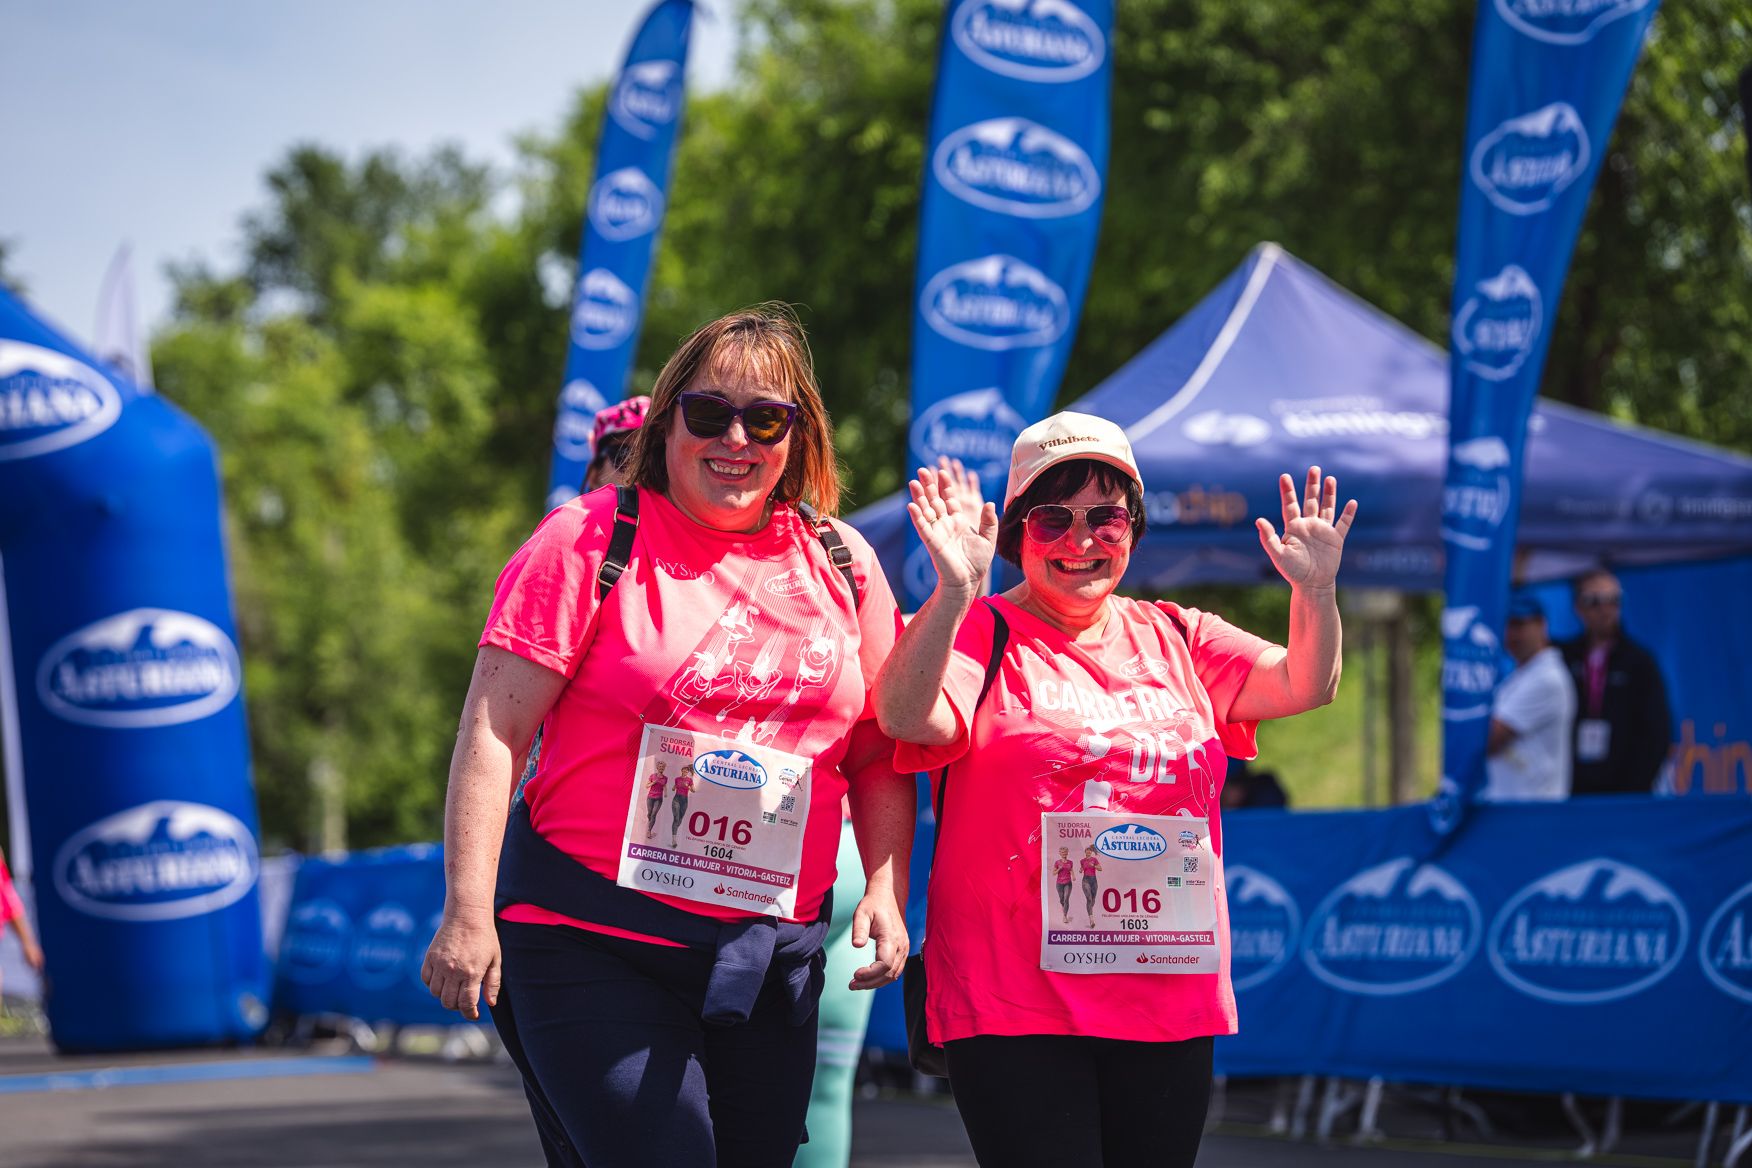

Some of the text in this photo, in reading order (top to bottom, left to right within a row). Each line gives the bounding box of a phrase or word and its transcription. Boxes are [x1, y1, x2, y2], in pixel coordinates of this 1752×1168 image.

[655, 557, 715, 586] OYSHO
[1038, 680, 1183, 723] CARRERA
[660, 743, 694, 758] SUMA
[669, 737, 694, 748] DORSAL
[1128, 731, 1178, 784] DE
[699, 759, 762, 784] ASTURIANA
[688, 811, 753, 845] 016
[1059, 829, 1092, 838] SUMA
[1101, 836, 1162, 851] ASTURIANA
[703, 845, 733, 860] 1604
[631, 846, 791, 886] CARRERA DE LA MUJER VITORIA-GASTEIZ
[641, 868, 694, 889] OYSHO
[726, 886, 777, 905] Santander
[1102, 888, 1161, 914] 016
[1120, 919, 1149, 930] 1603
[1051, 933, 1211, 943] CARRERA DE LA MUJER VITORIA-GASTEIZ
[1064, 952, 1117, 964] OYSHO
[1150, 954, 1200, 964] Santander
